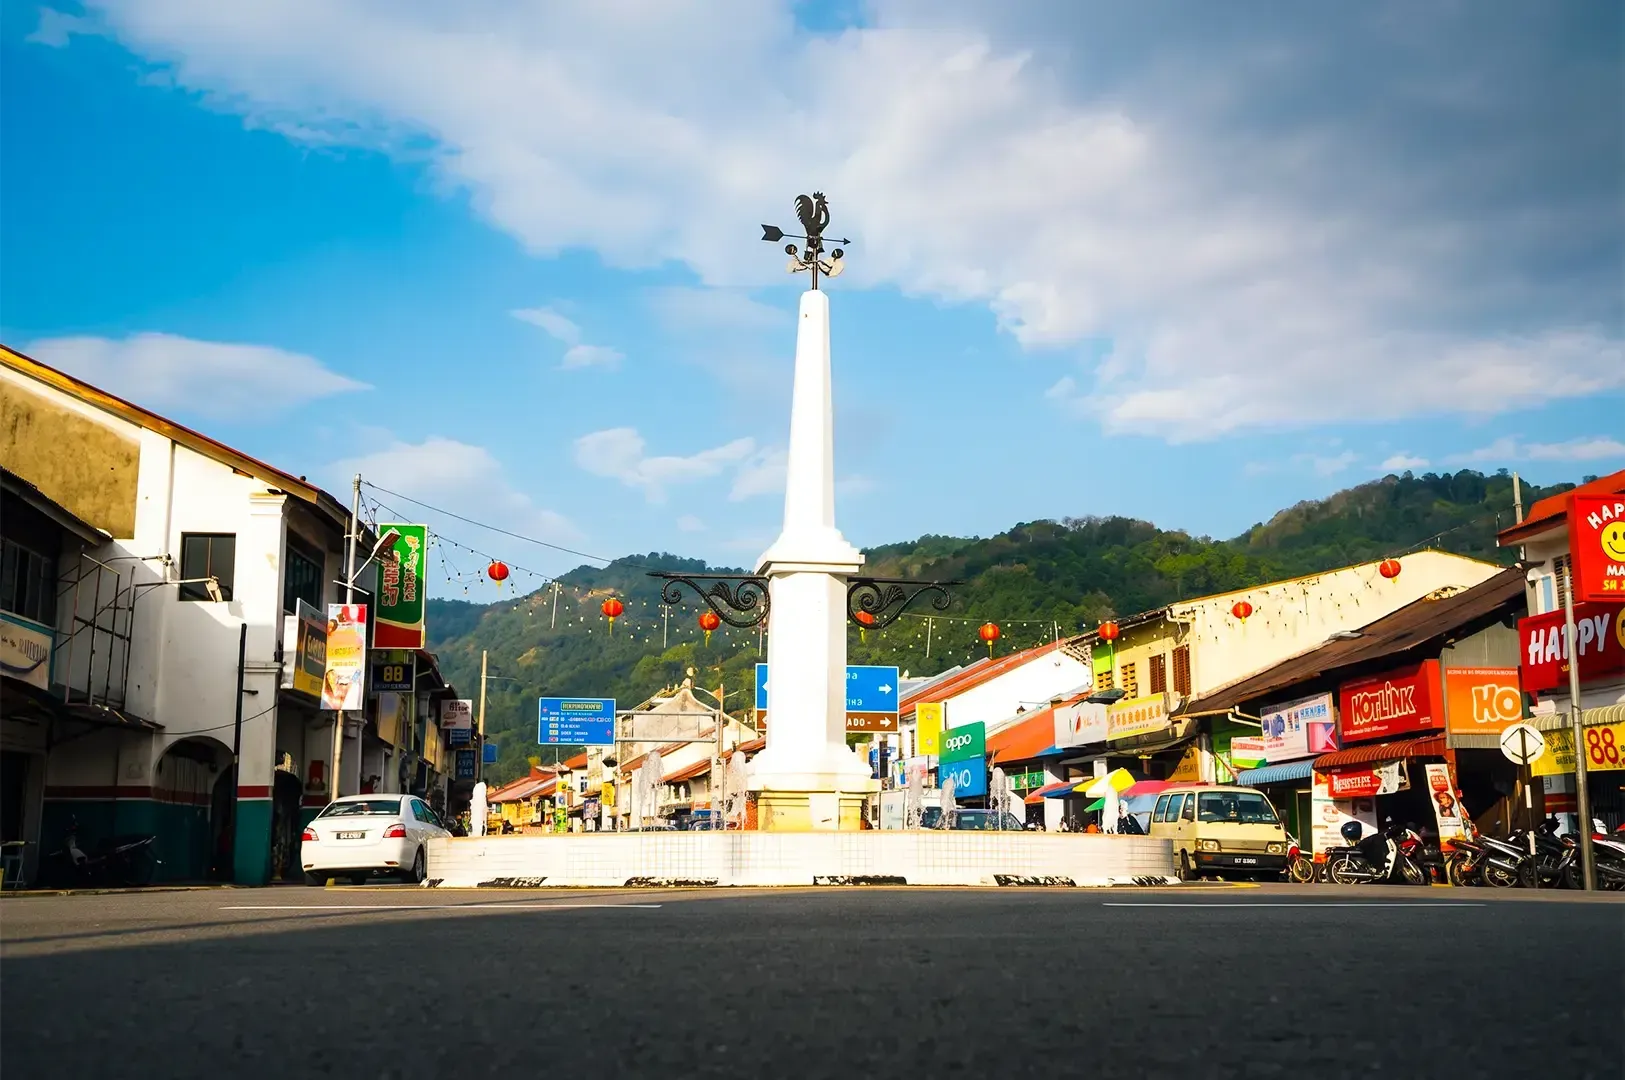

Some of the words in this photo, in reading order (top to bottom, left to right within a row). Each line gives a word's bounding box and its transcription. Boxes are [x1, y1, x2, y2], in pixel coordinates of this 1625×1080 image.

[1528, 613, 1610, 666] HAPPY
[383, 665, 403, 682] 88
[1587, 727, 1619, 765] 88
